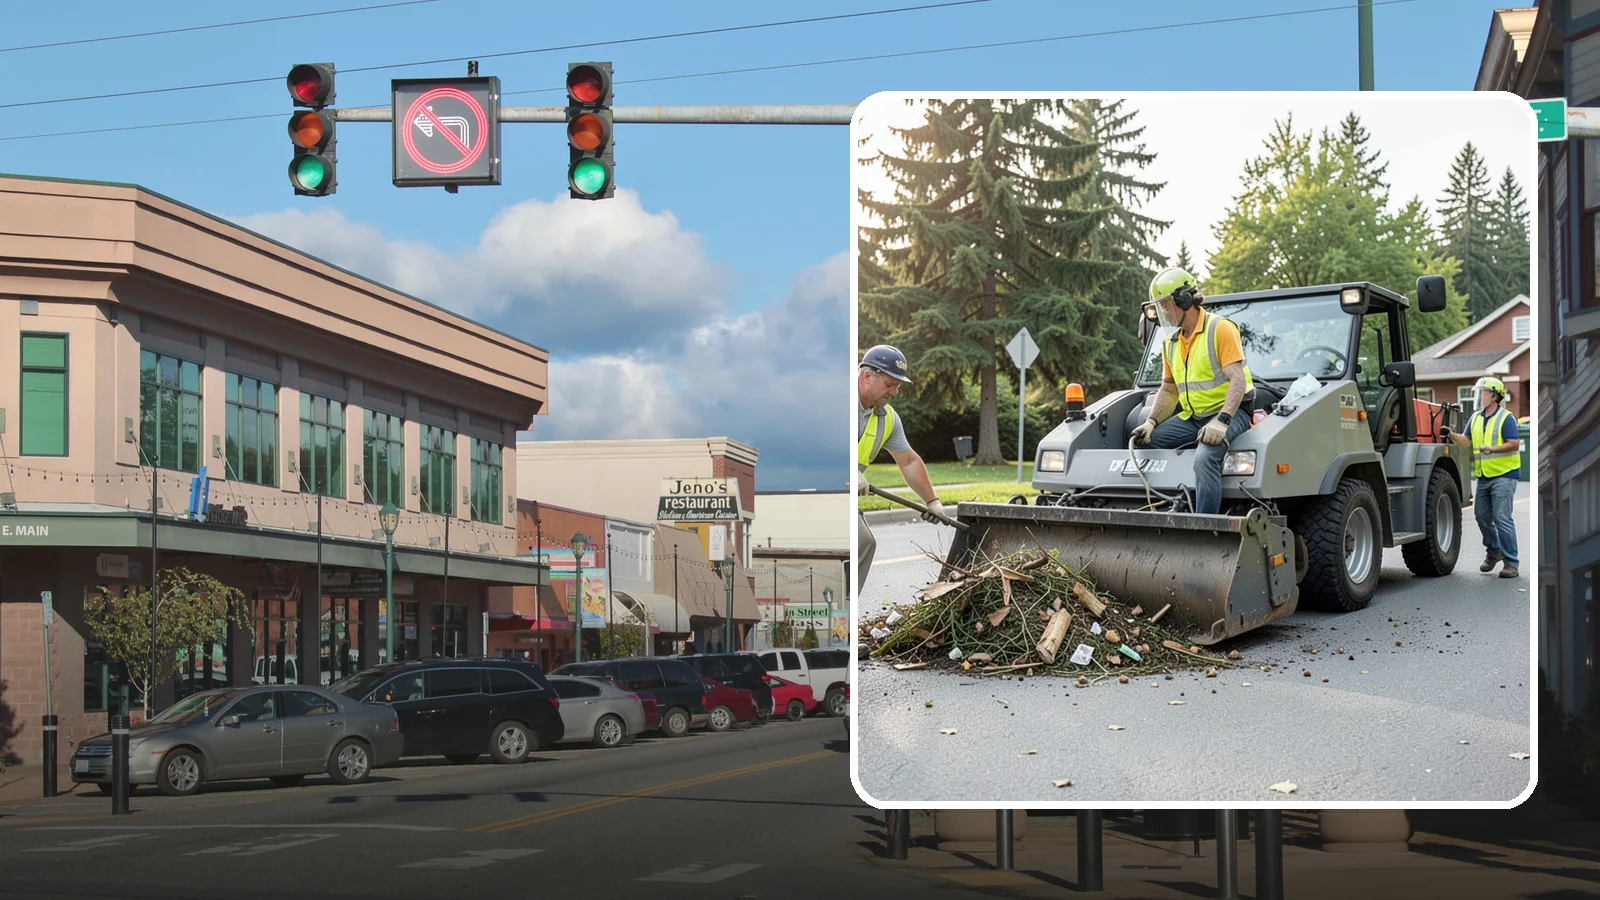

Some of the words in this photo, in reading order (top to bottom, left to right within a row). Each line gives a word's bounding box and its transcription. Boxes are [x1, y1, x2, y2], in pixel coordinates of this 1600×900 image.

[670, 480, 727, 494] Jeno's
[665, 496, 731, 509] restaurant
[686, 509, 714, 519] American
[715, 509, 737, 519] Cuisine
[2, 525, 13, 536] E.
[15, 525, 49, 536] MAIN
[797, 607, 828, 617] Street
